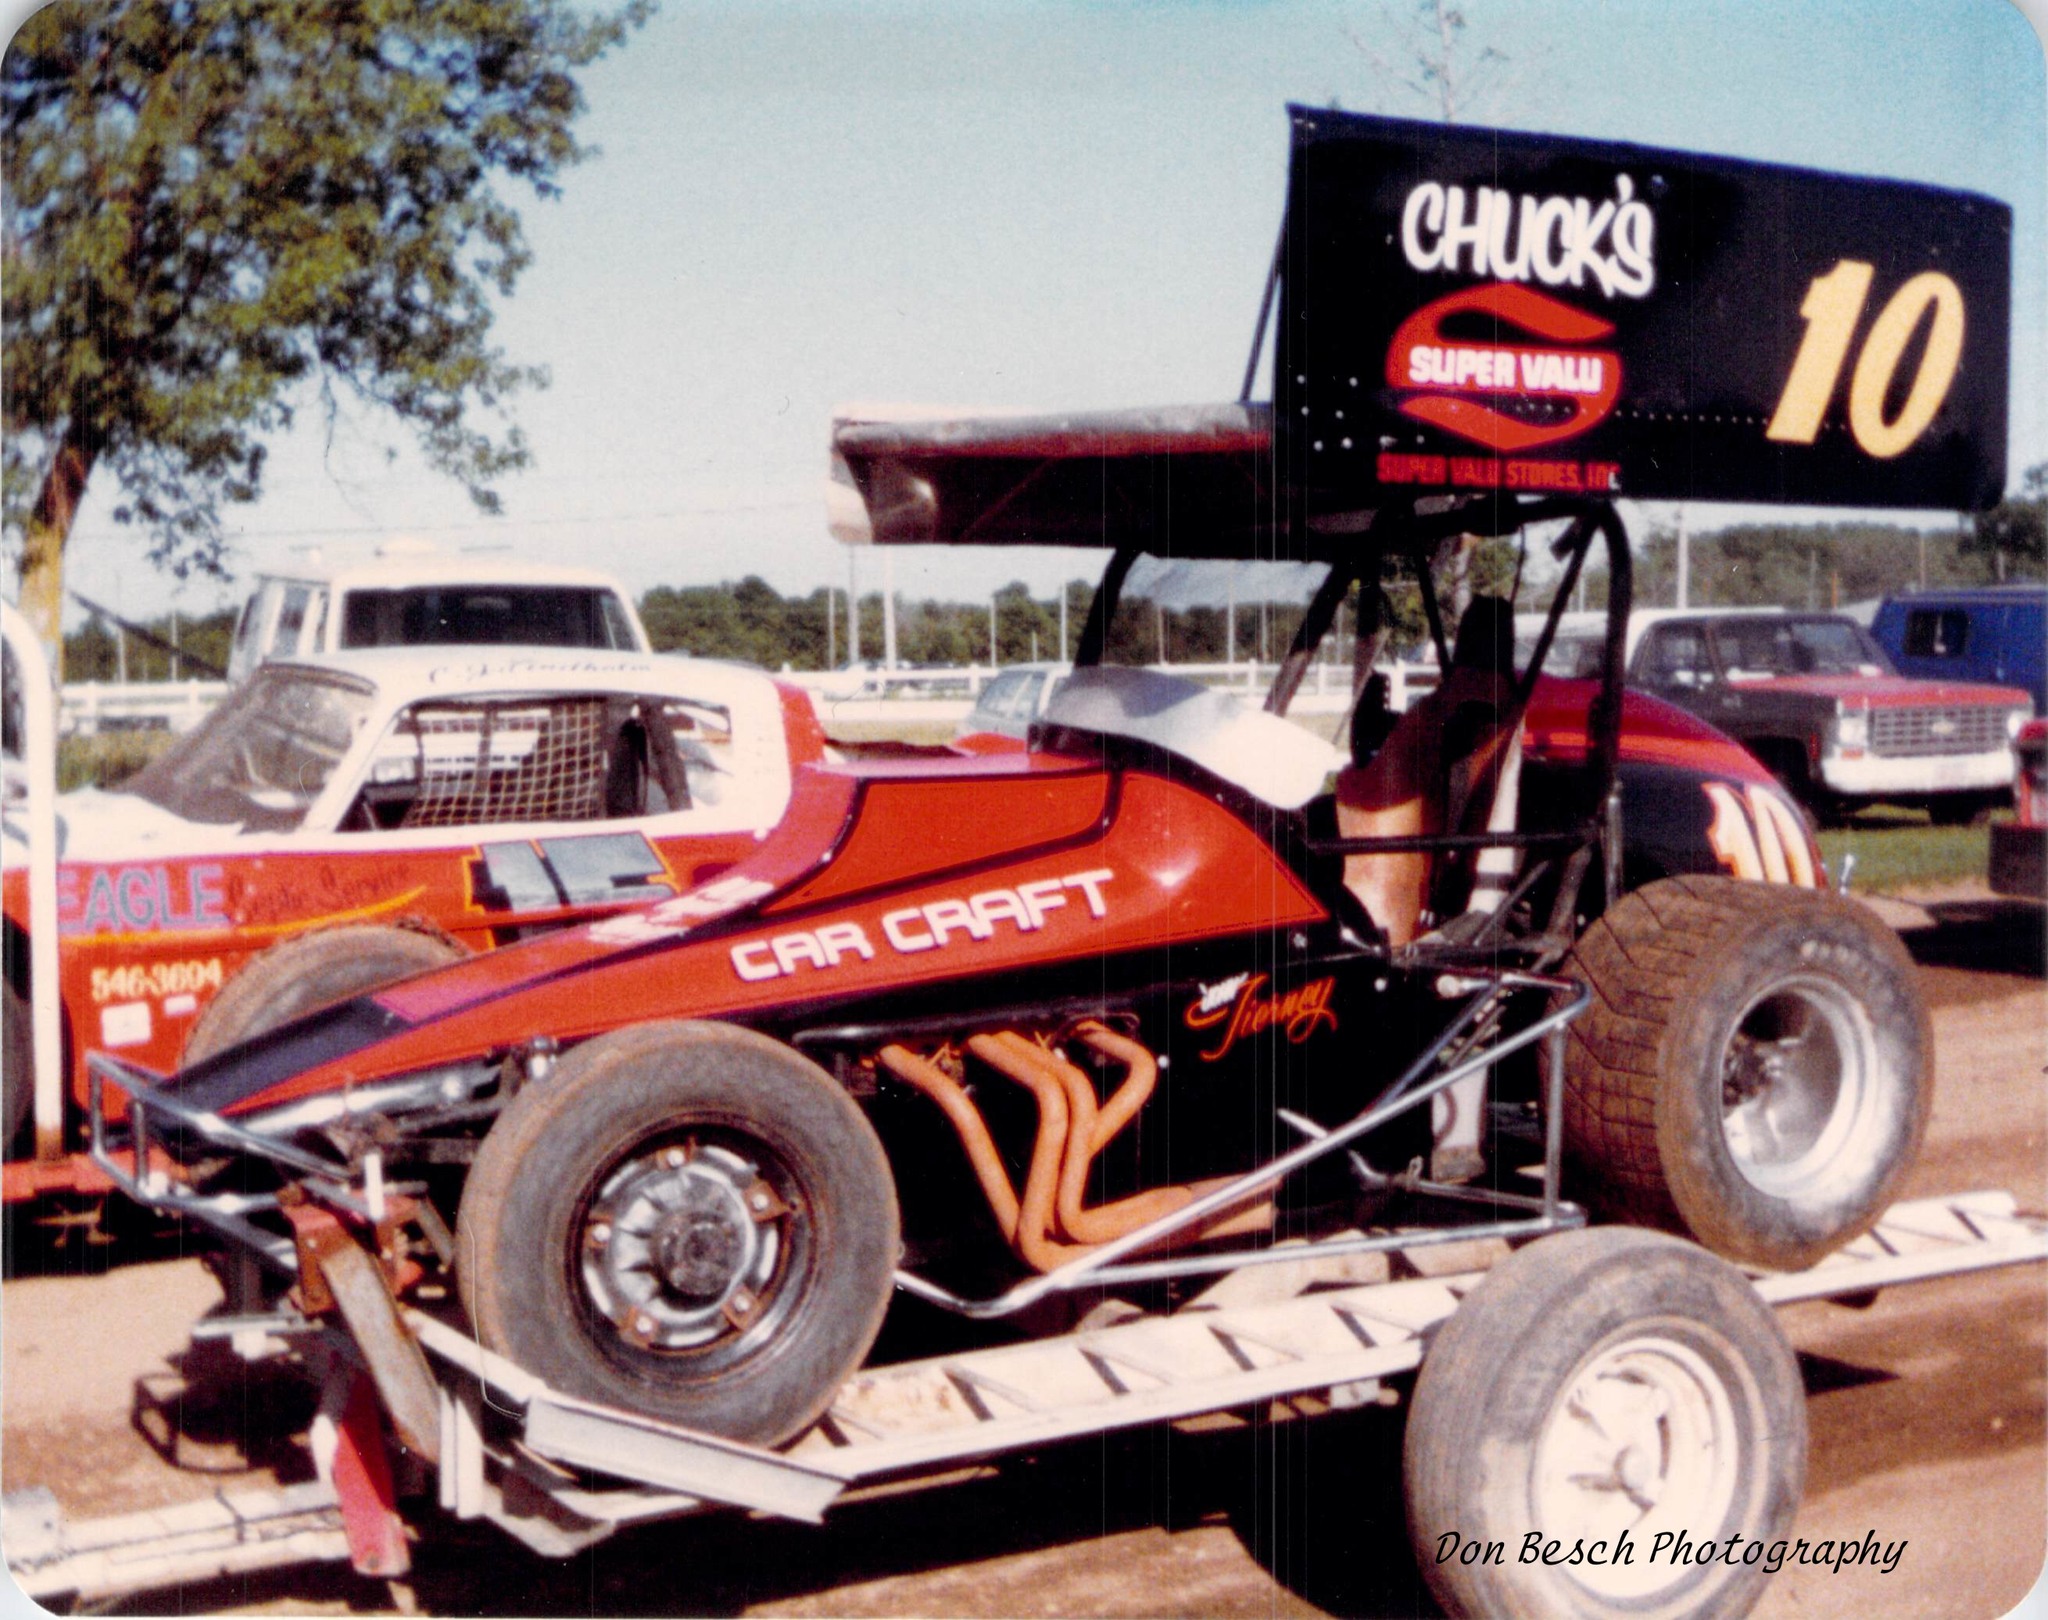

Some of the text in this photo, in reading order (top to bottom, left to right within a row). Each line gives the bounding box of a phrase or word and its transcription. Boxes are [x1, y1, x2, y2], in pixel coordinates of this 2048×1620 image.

[1402, 174, 1655, 298] CHUCK'S
[1409, 345, 1603, 393] SUPER VALU
[1766, 259, 1966, 458] 10
[1377, 453, 1448, 485] SUPER
[730, 868, 1115, 982] CAR CRAFT
